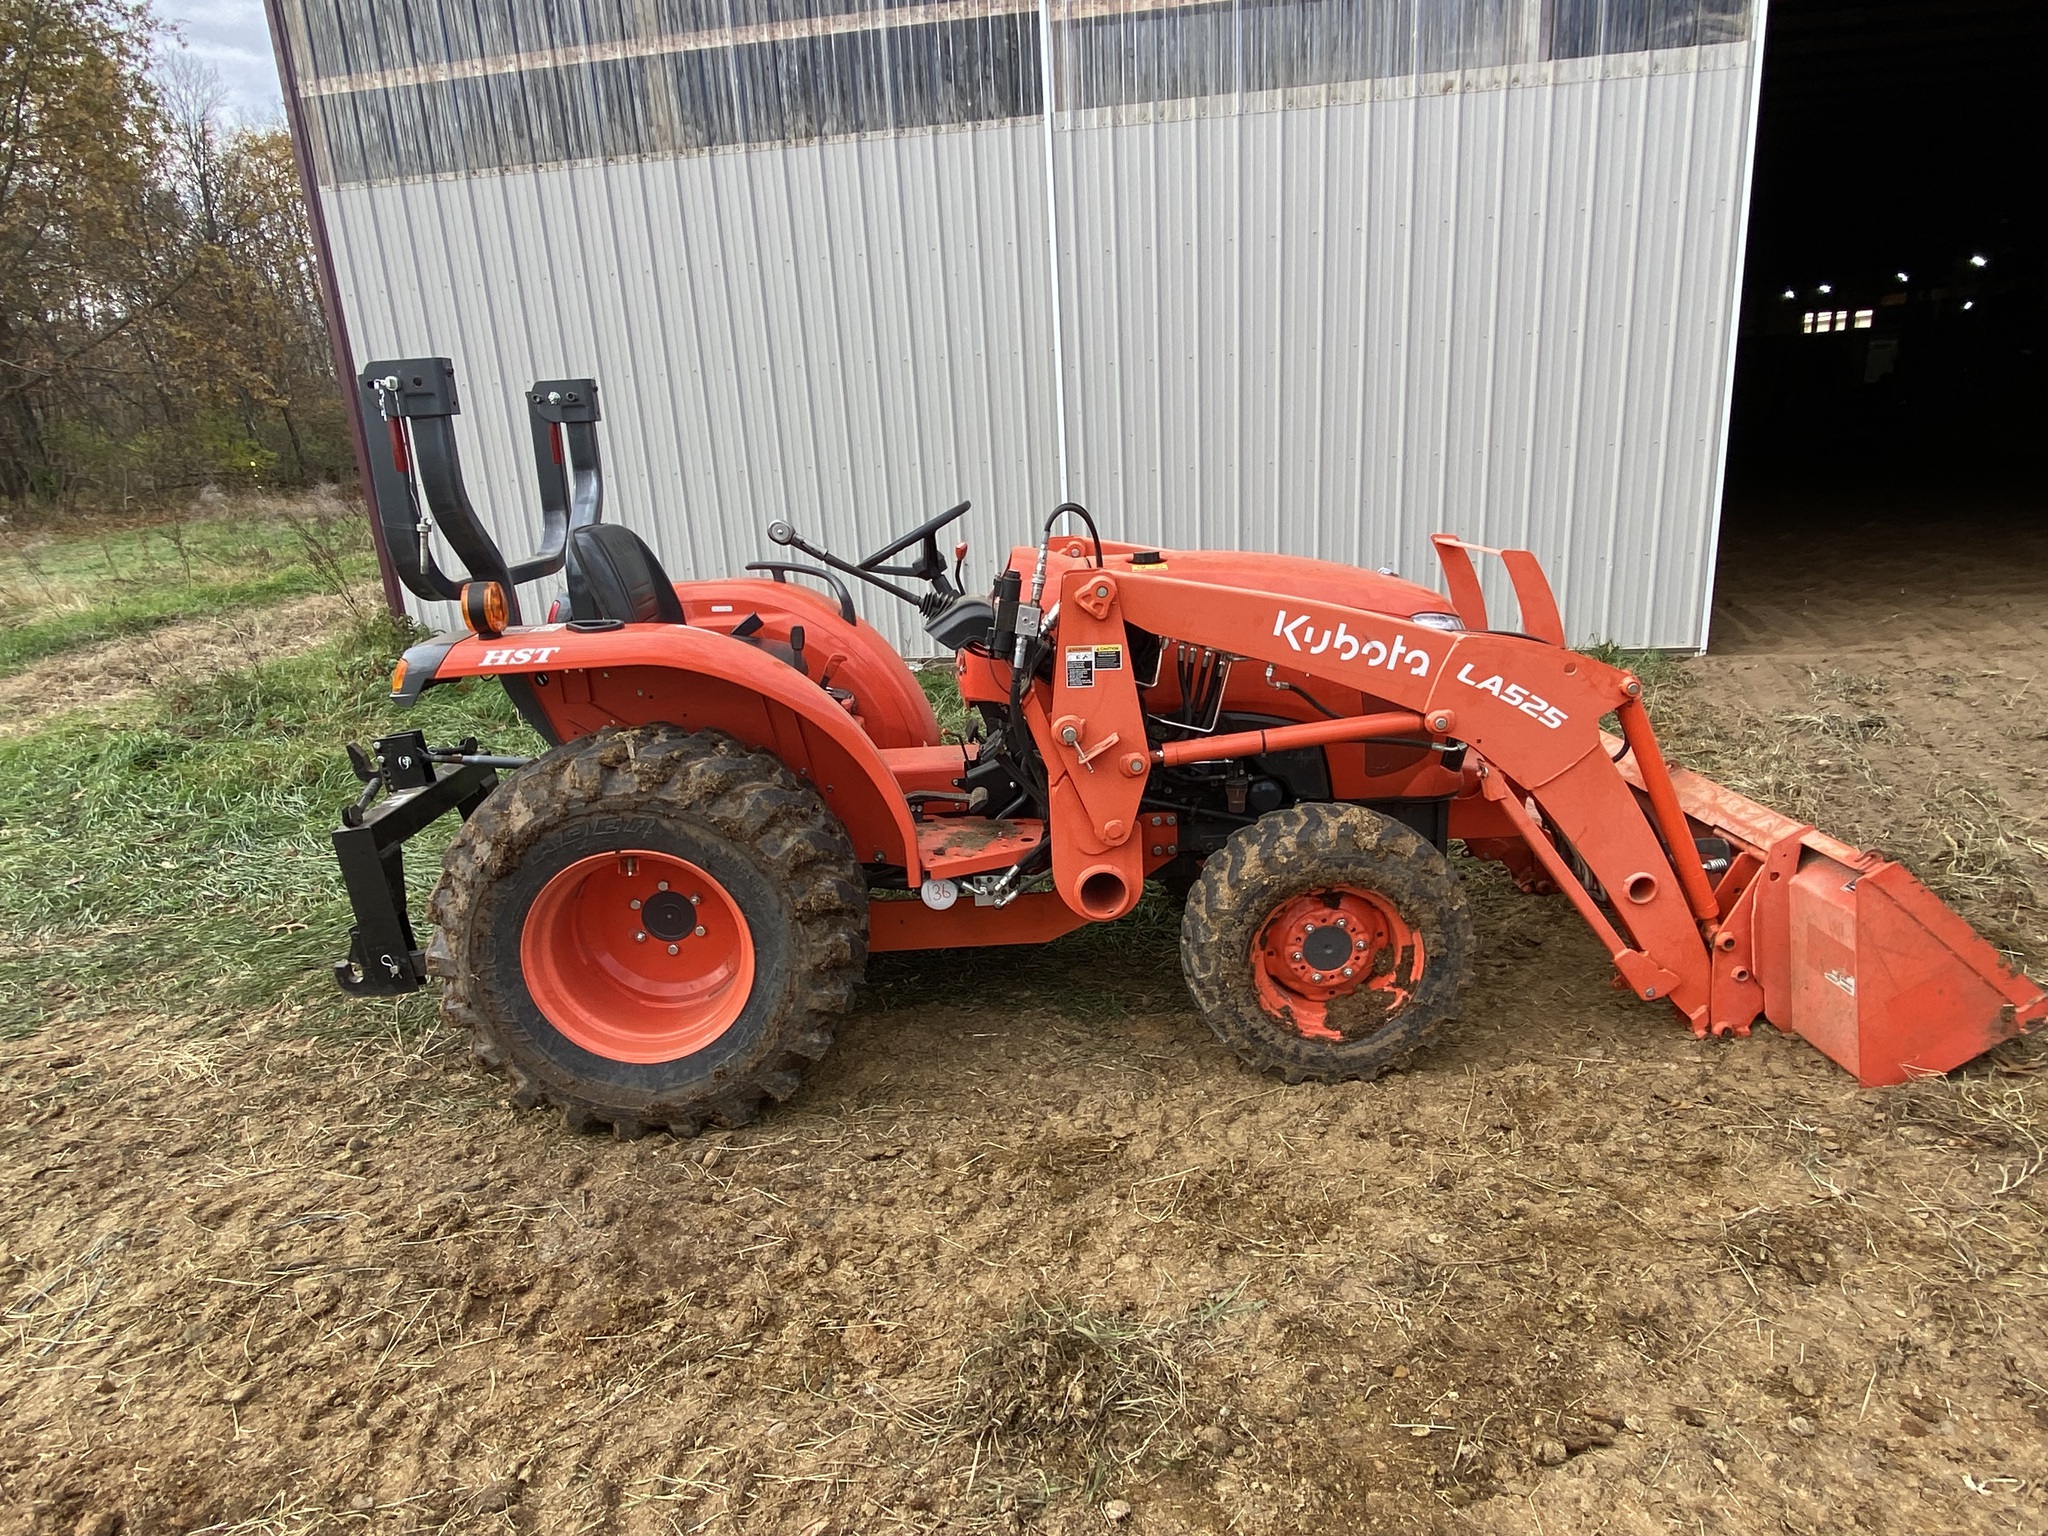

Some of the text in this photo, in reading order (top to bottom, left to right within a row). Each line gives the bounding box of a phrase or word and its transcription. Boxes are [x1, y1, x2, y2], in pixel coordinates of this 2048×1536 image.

[478, 646, 561, 667] HST
[1272, 609, 1431, 678] Kubota
[1456, 662, 1569, 730] LA525
[926, 883, 951, 902] 136
